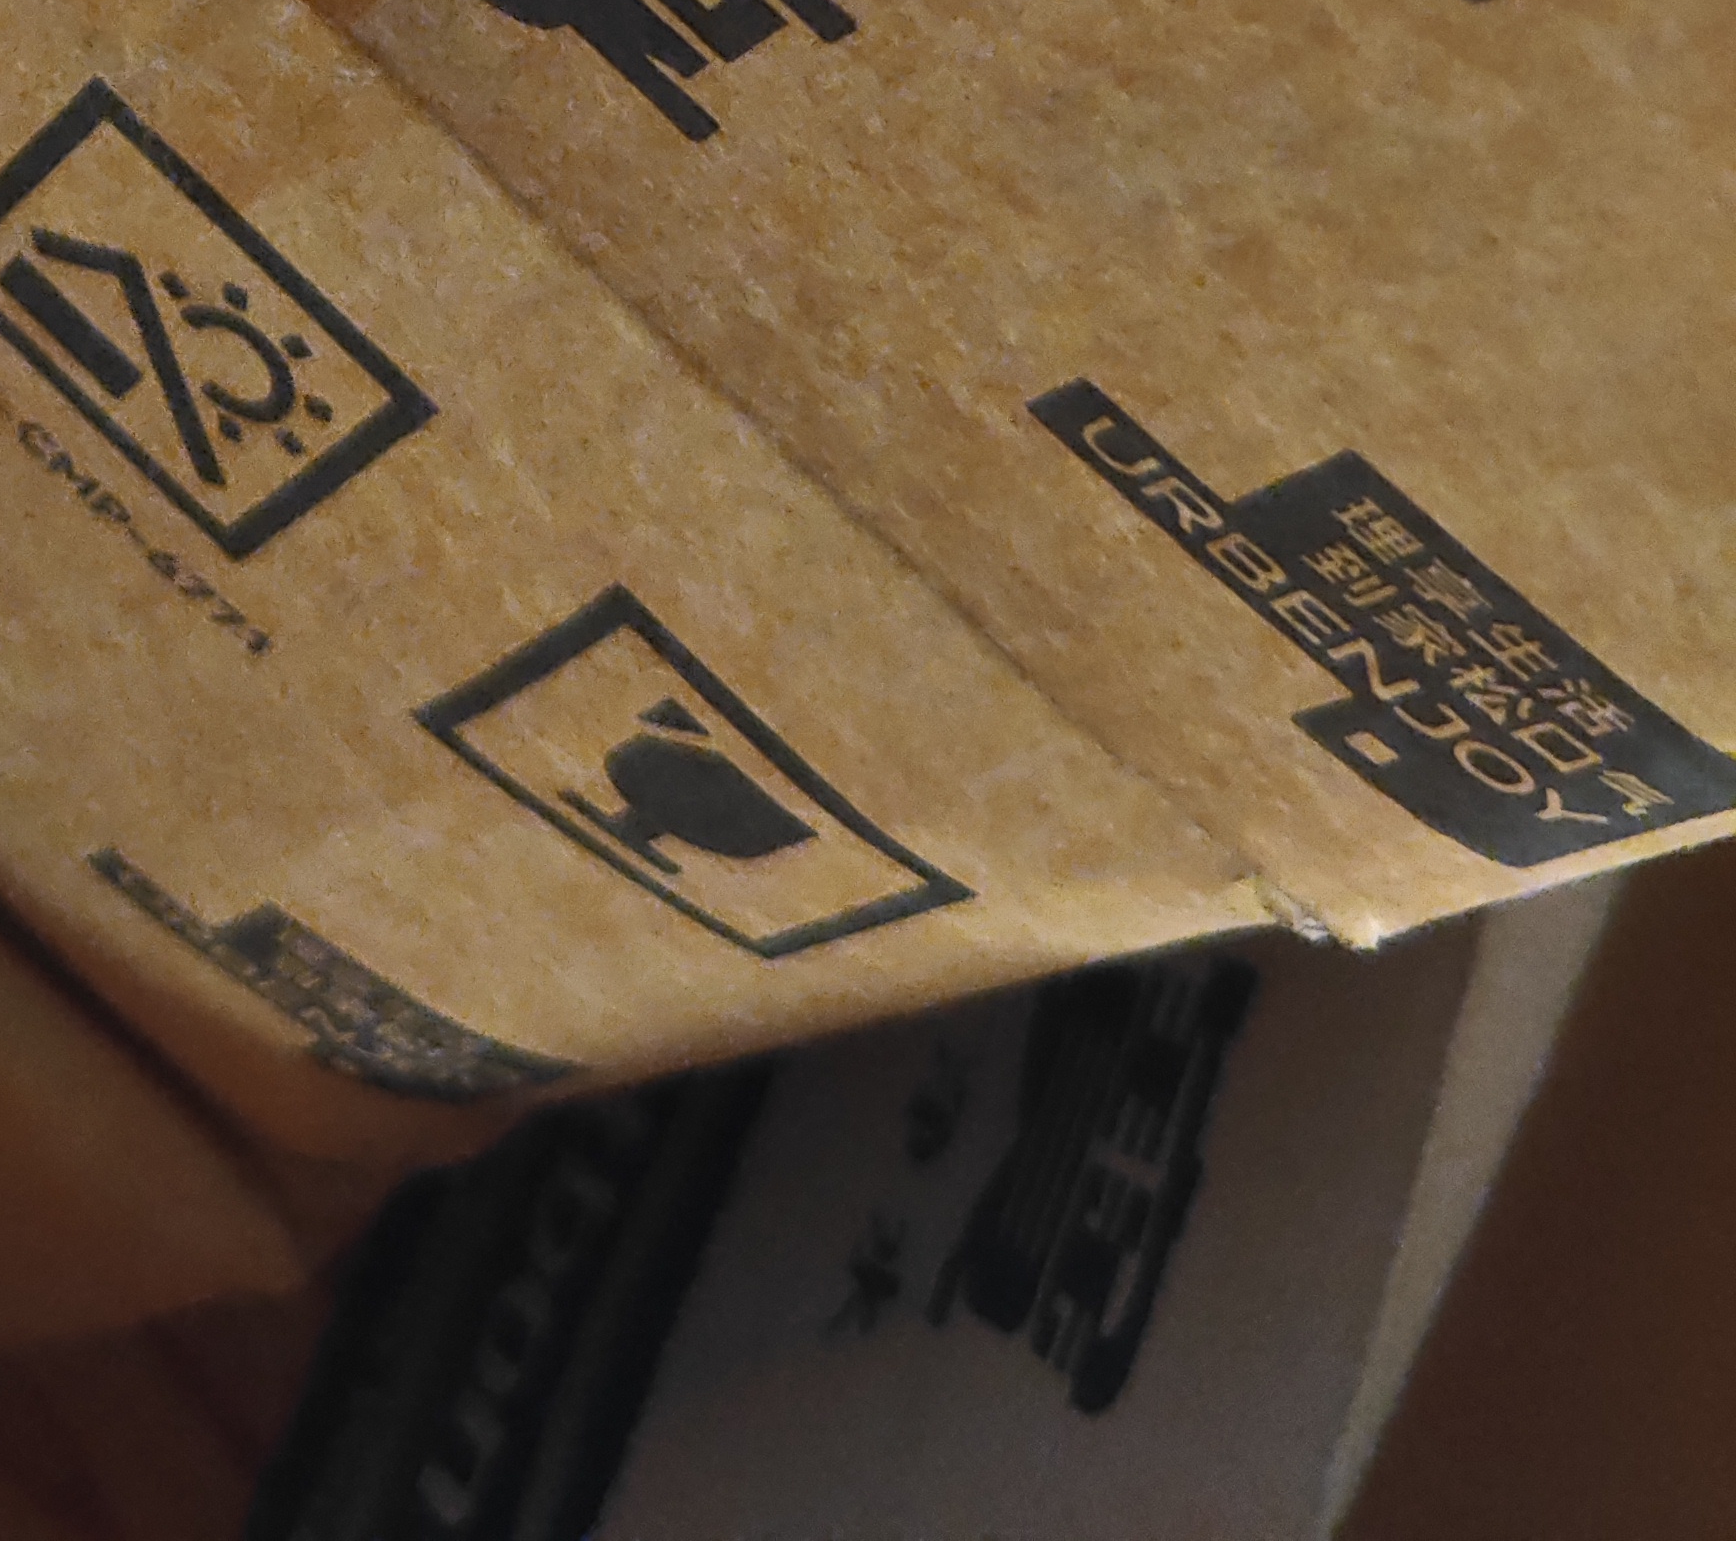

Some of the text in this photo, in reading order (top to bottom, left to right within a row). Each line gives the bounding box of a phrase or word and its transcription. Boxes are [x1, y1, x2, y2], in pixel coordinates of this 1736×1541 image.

[1080, 417, 1610, 825] URBENJOY
[1300, 541, 1676, 819] 到家松口气
[1330, 495, 1636, 740] 理享生活
